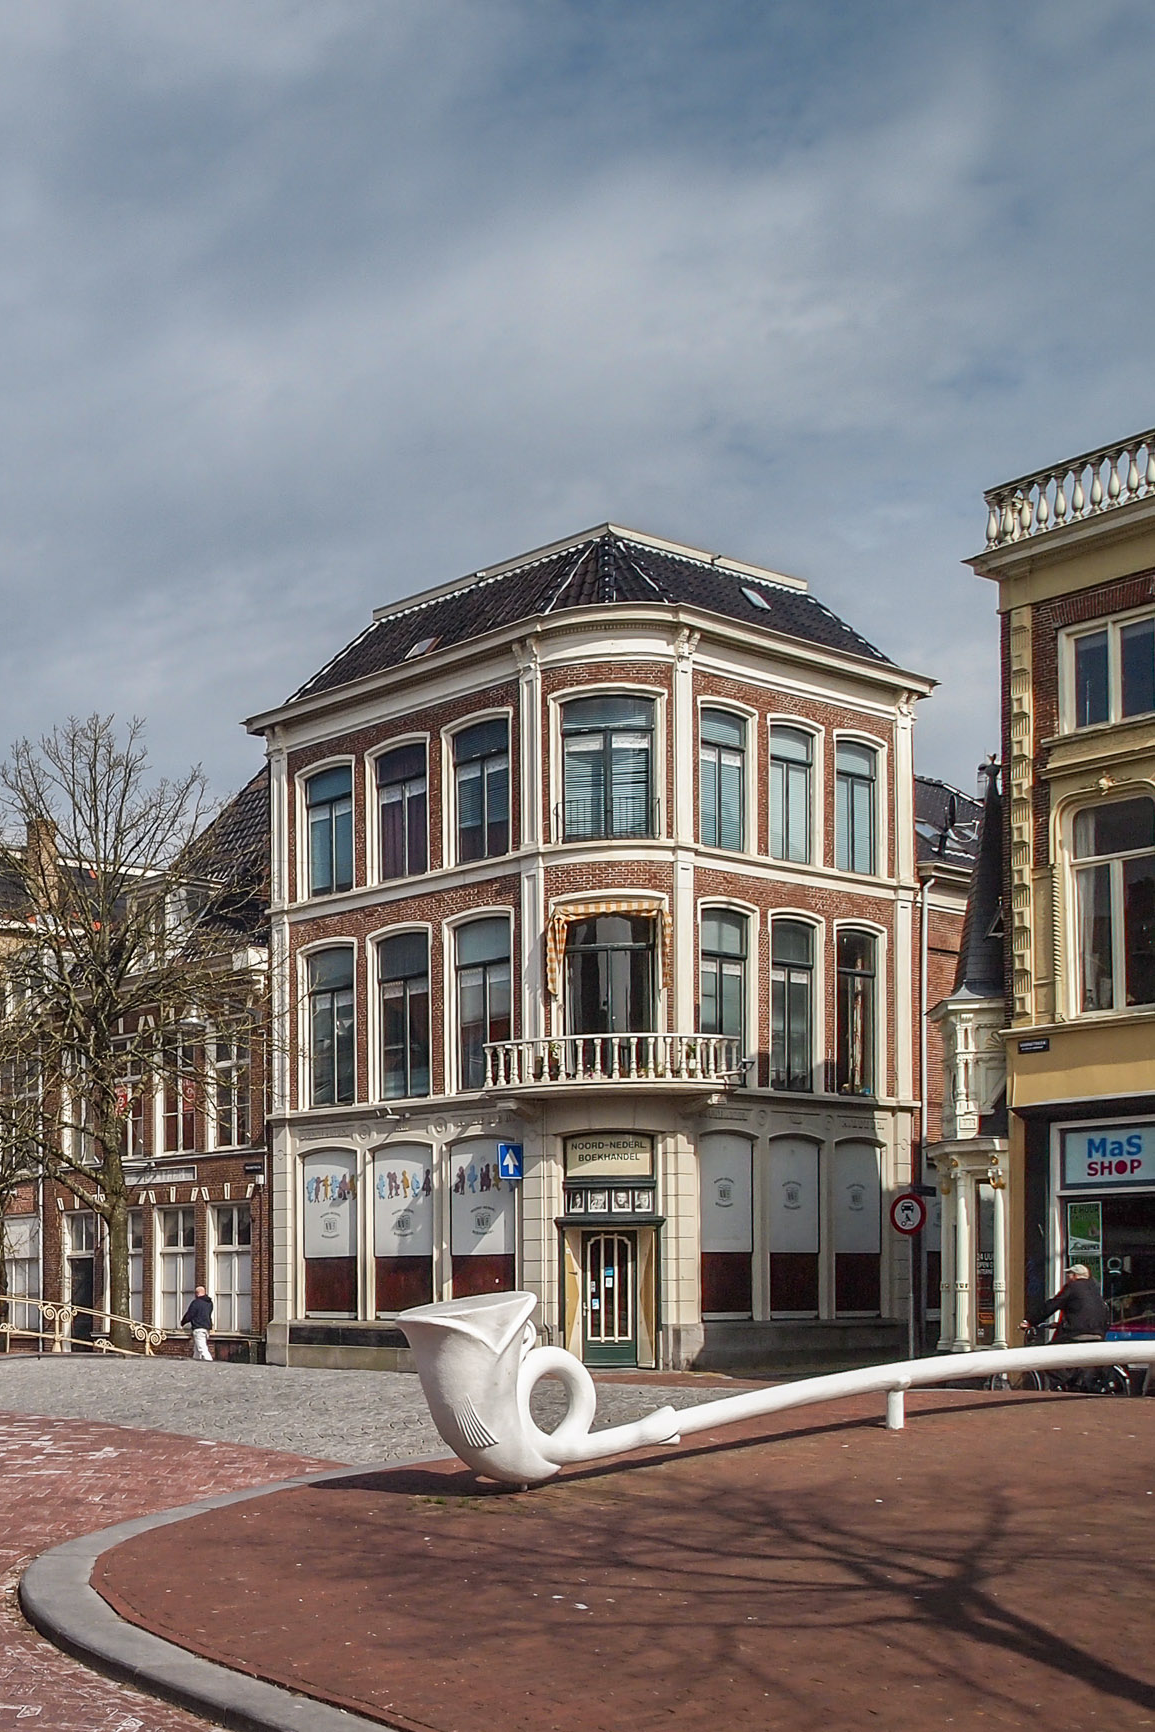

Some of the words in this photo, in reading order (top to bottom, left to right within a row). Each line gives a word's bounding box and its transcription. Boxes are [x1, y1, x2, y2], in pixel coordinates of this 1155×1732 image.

[1087, 1134, 1142, 1158] MaS
[578, 1152, 640, 1162] BOEKHANDEL
[1087, 1159, 1142, 1176] SHOP
